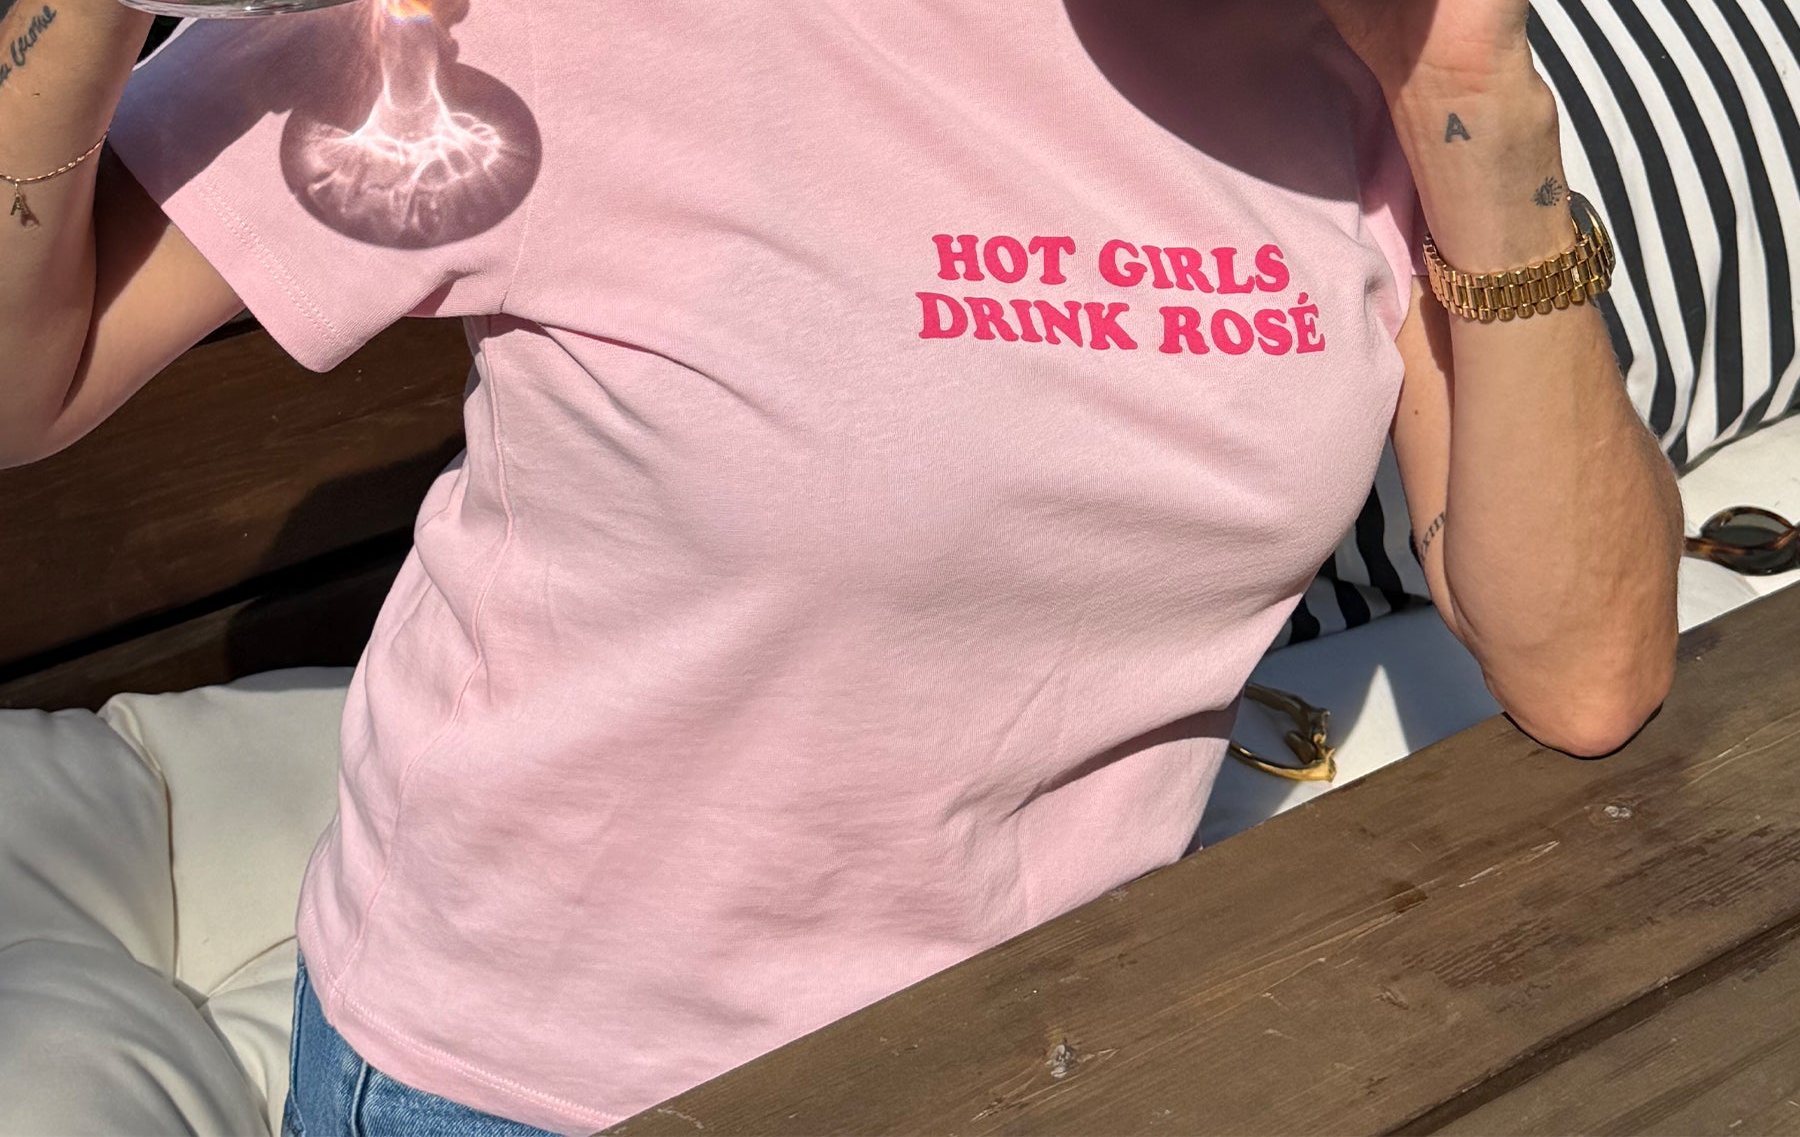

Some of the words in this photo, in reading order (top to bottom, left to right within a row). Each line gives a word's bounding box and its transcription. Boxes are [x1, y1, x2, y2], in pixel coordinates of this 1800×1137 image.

[1444, 112, 1472, 143] A
[931, 233, 1076, 286] HOT
[1099, 239, 1290, 295] GIRLS
[915, 291, 1138, 351] DRINK
[1158, 292, 1326, 356] ROSÉ
